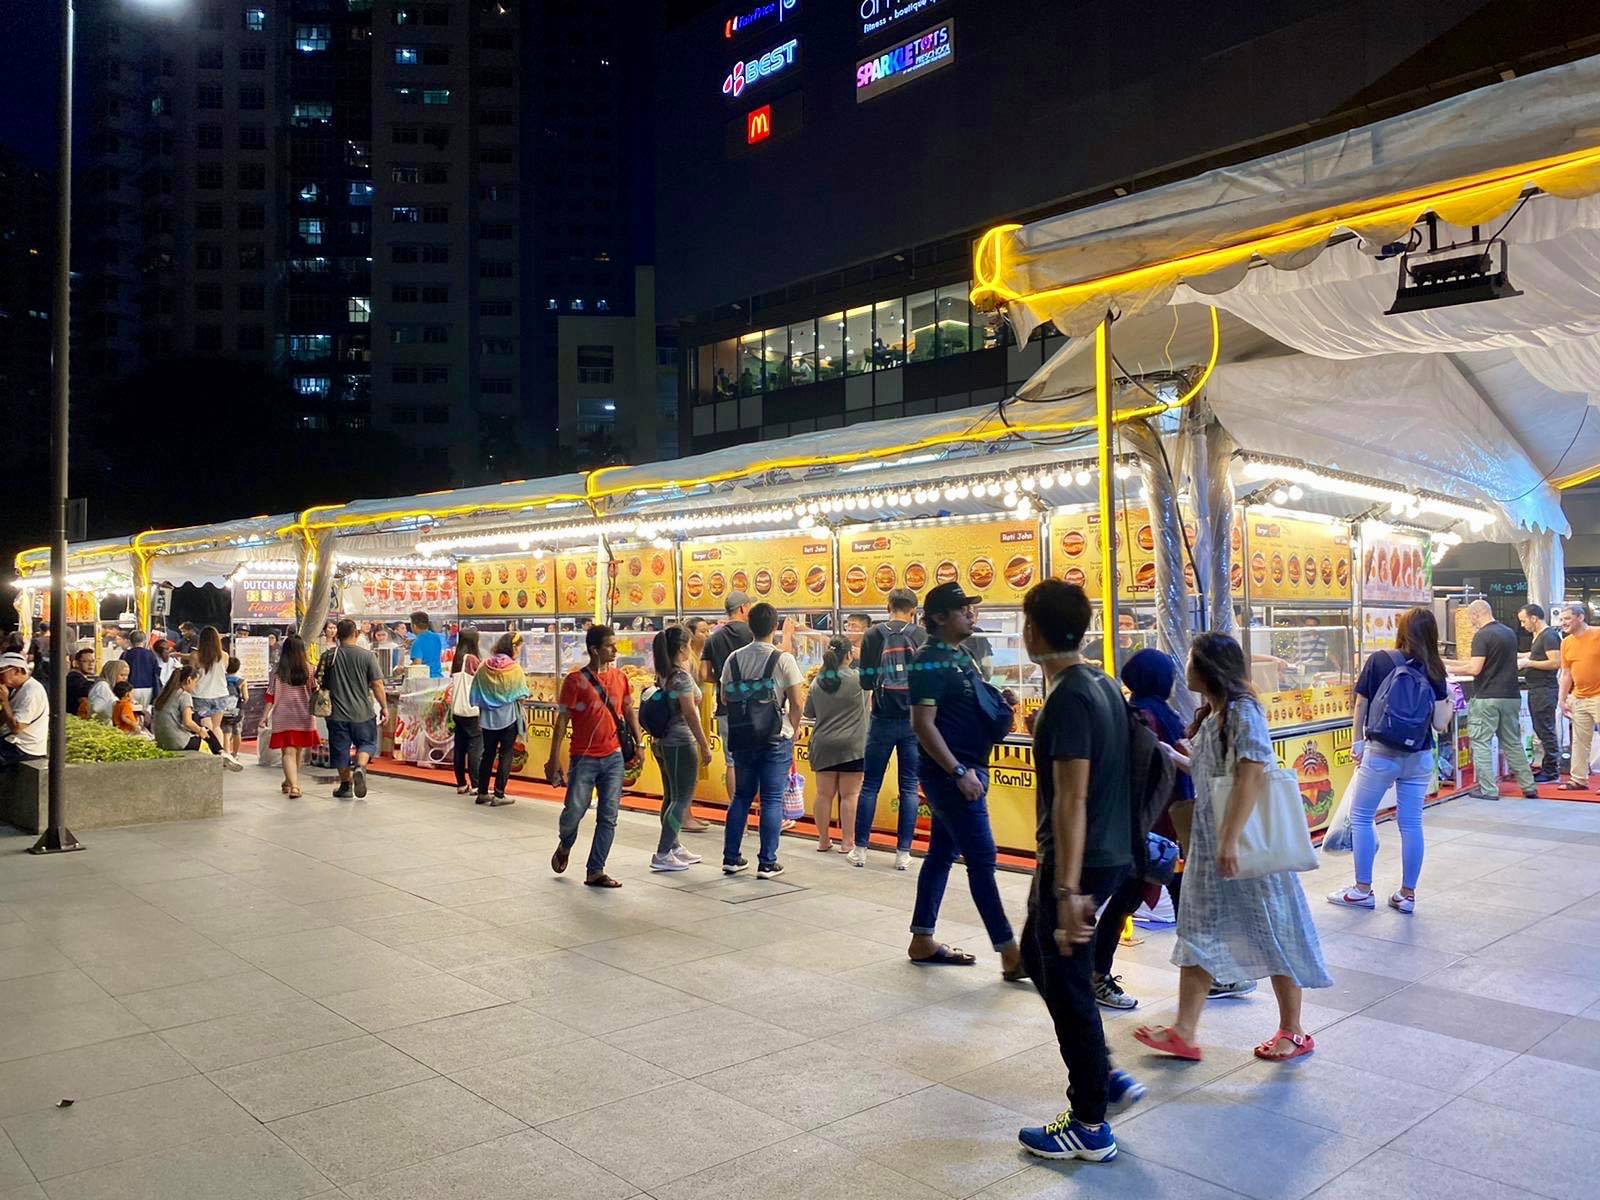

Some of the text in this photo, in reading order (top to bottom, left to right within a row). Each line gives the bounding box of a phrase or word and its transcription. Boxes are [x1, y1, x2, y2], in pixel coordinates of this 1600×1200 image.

[745, 39, 797, 83] BEST
[243, 580, 275, 590] DUTCH
[276, 580, 296, 590] BAB
[994, 769, 1032, 787] Ramly
